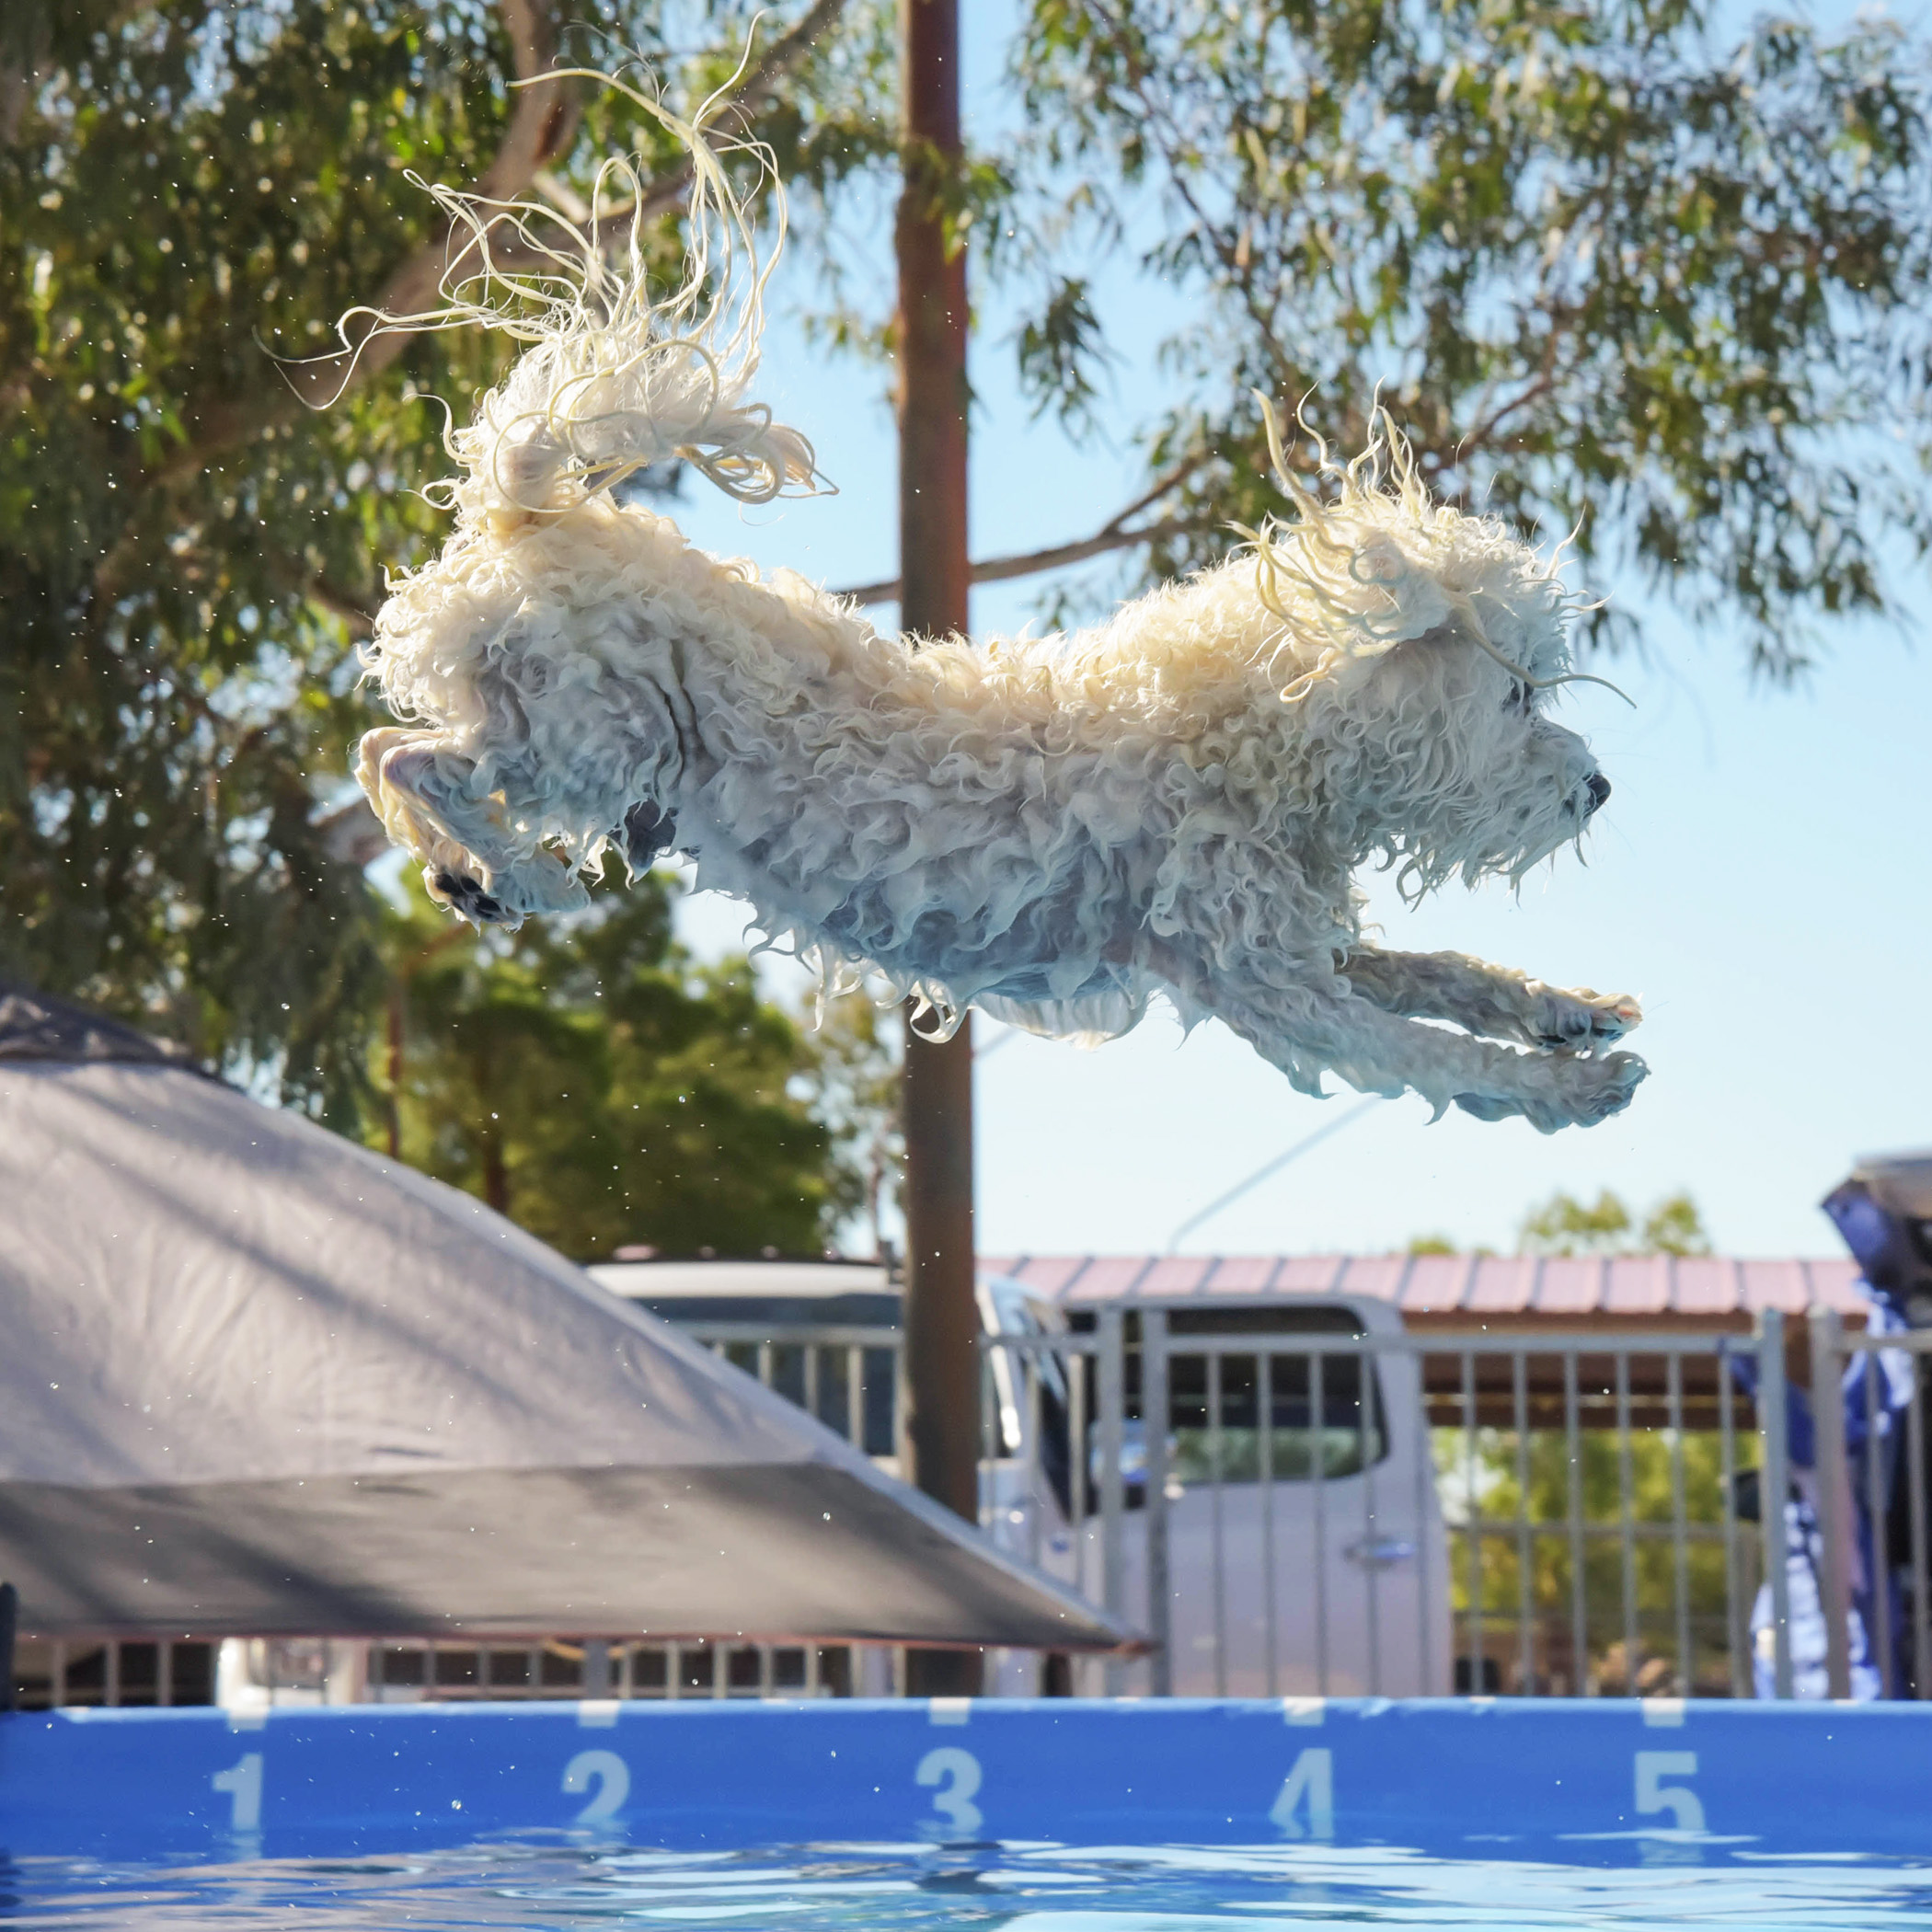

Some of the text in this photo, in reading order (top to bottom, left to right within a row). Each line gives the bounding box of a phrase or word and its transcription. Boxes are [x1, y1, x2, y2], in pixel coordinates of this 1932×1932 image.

[213, 1754, 263, 1831] 1
[562, 1750, 630, 1824] 2
[916, 1748, 983, 1833] 3
[1270, 1748, 1333, 1838] 4
[1635, 1751, 1706, 1834] 5
